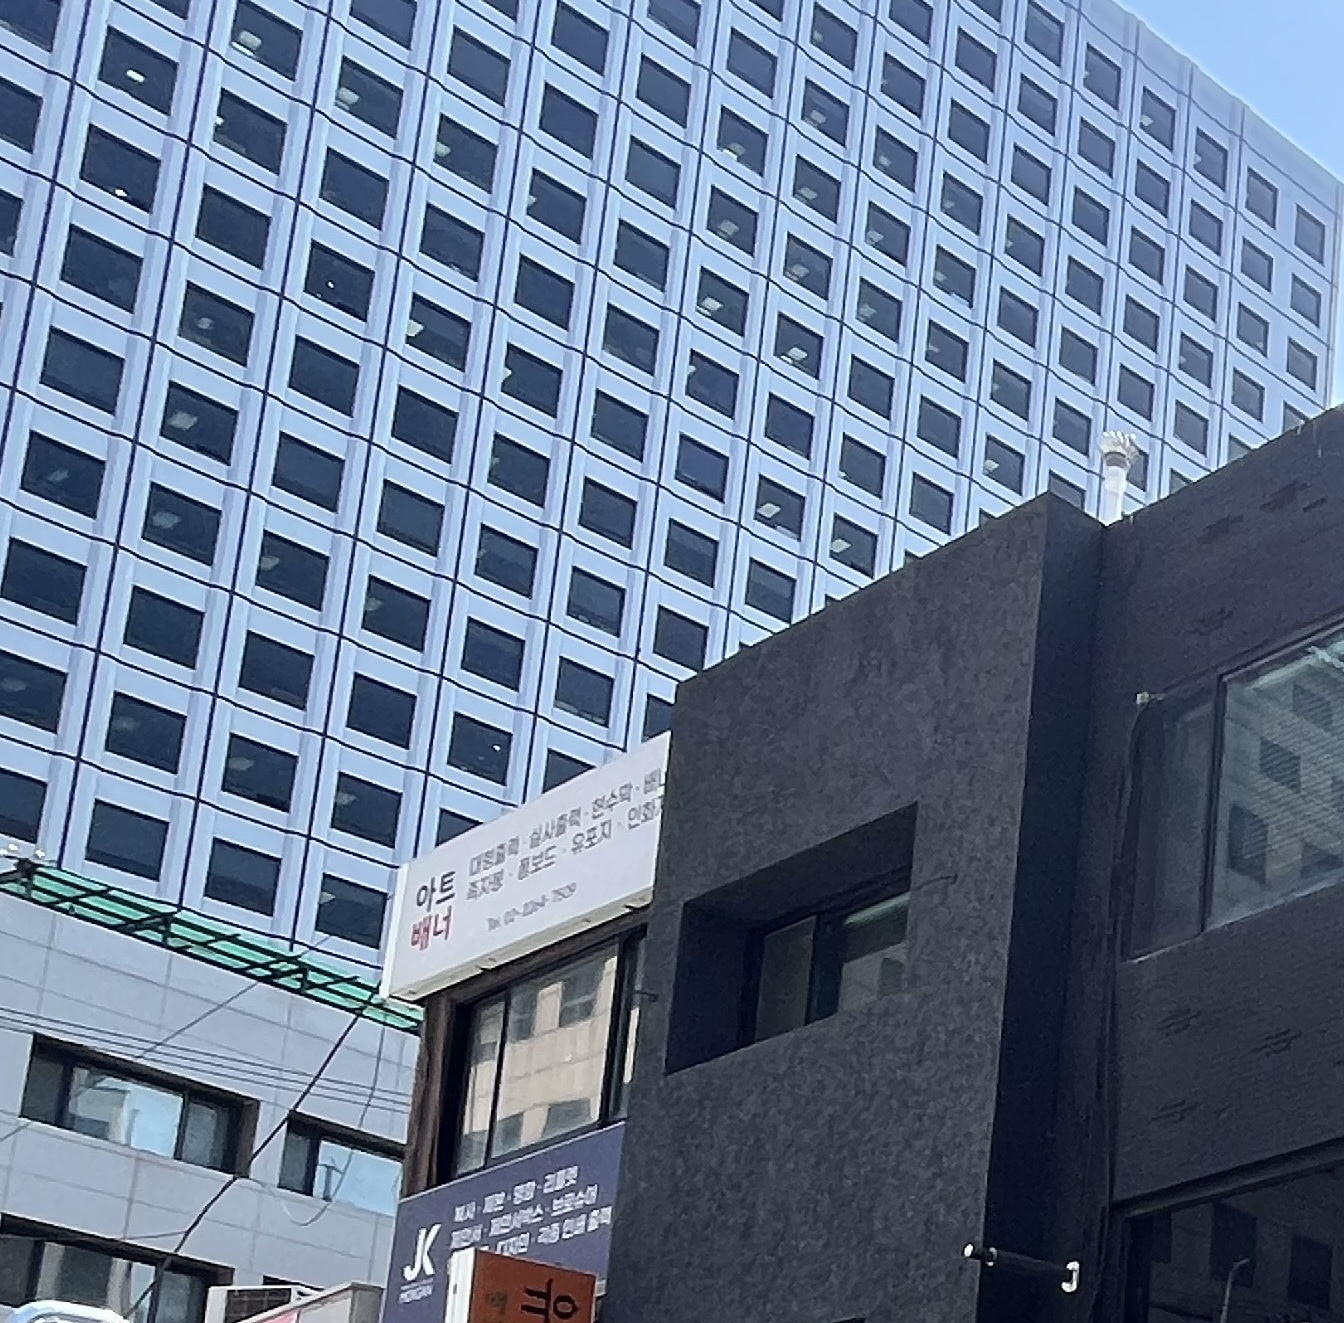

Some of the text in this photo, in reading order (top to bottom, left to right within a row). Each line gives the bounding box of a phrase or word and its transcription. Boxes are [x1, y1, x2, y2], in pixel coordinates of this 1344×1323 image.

[416, 870, 457, 913] 아트
[410, 906, 453, 950] 배너
[403, 1223, 442, 1281] JK
